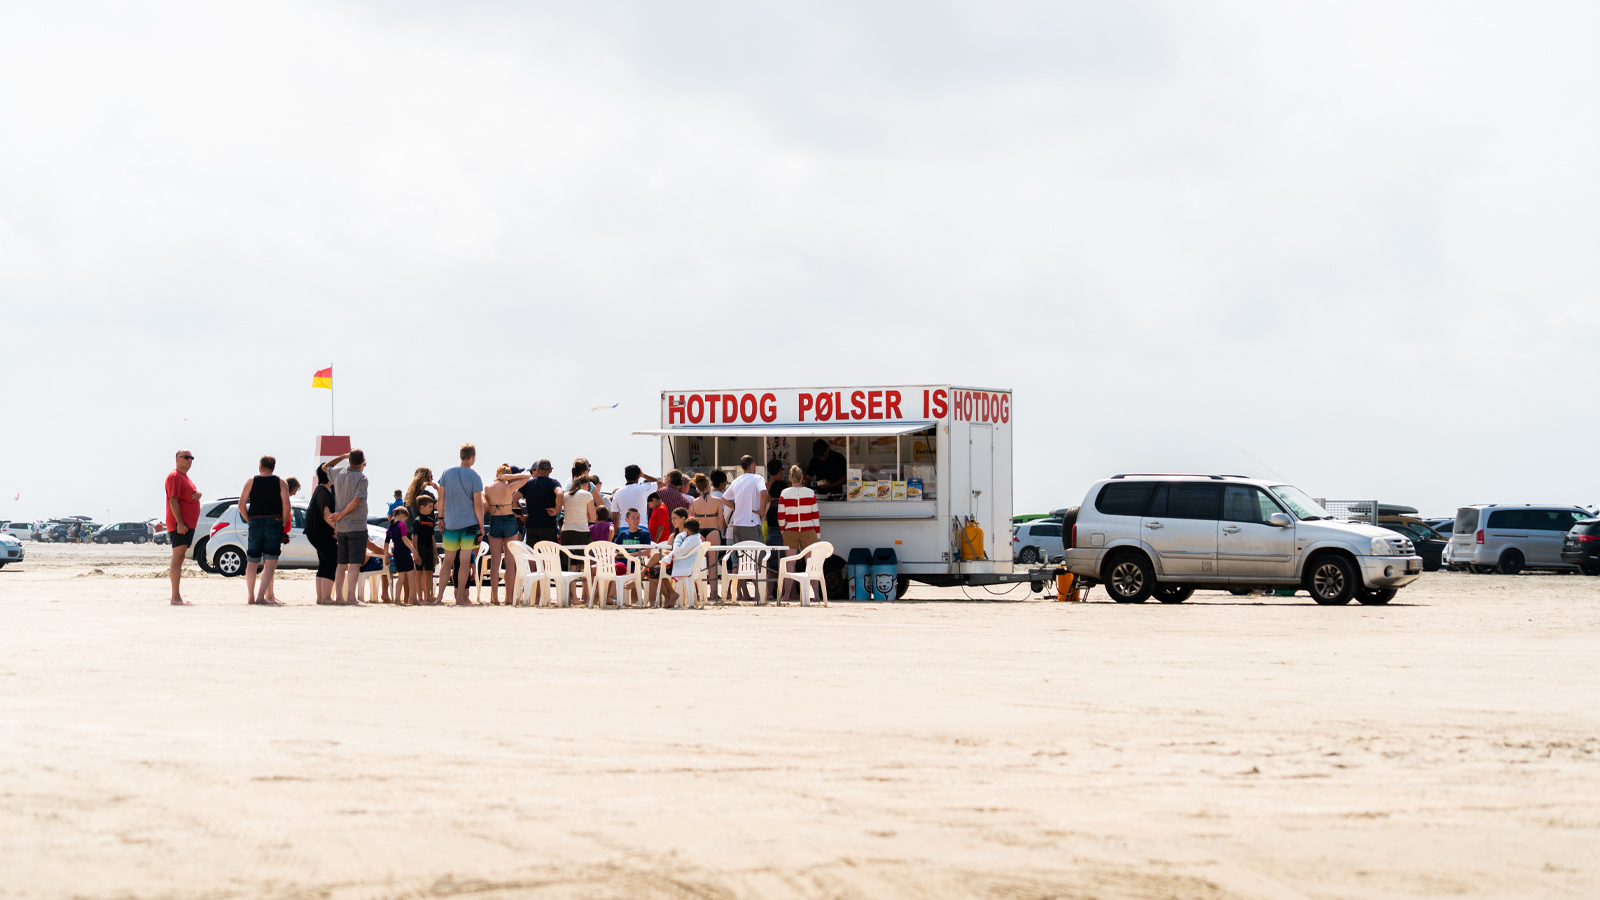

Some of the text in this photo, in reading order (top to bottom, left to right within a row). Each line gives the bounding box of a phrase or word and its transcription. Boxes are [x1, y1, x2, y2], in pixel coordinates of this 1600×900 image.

[668, 389, 949, 425] HOTDOG PØLSER IS
[953, 391, 1009, 424] HOTDOG
